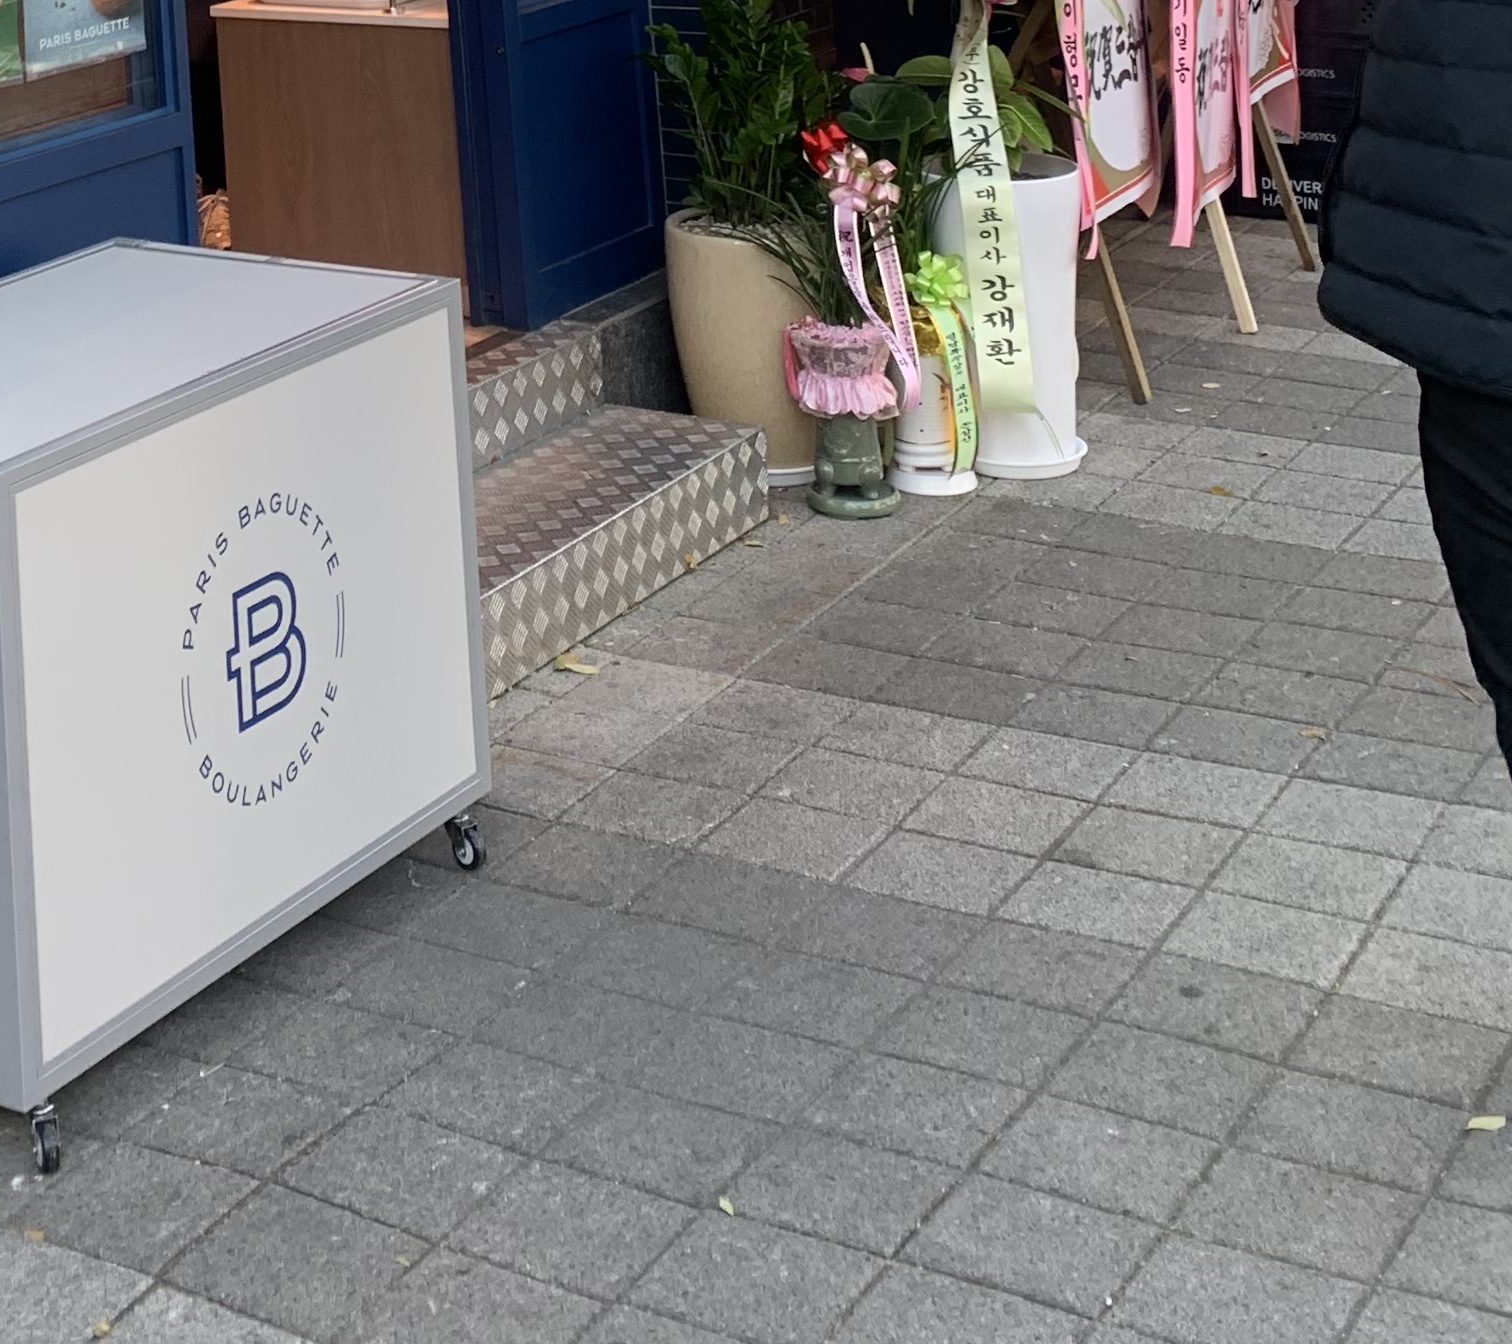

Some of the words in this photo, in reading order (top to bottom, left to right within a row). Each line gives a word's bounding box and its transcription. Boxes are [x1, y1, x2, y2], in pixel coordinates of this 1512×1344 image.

[39, 32, 72, 51] PARIS
[73, 16, 131, 42] BAGUETTE
[974, 186, 1007, 265] 대표이사
[181, 531, 230, 651] PARIS
[236, 491, 340, 577] BAGUETTE
[197, 679, 338, 808] BOULANGERIE
